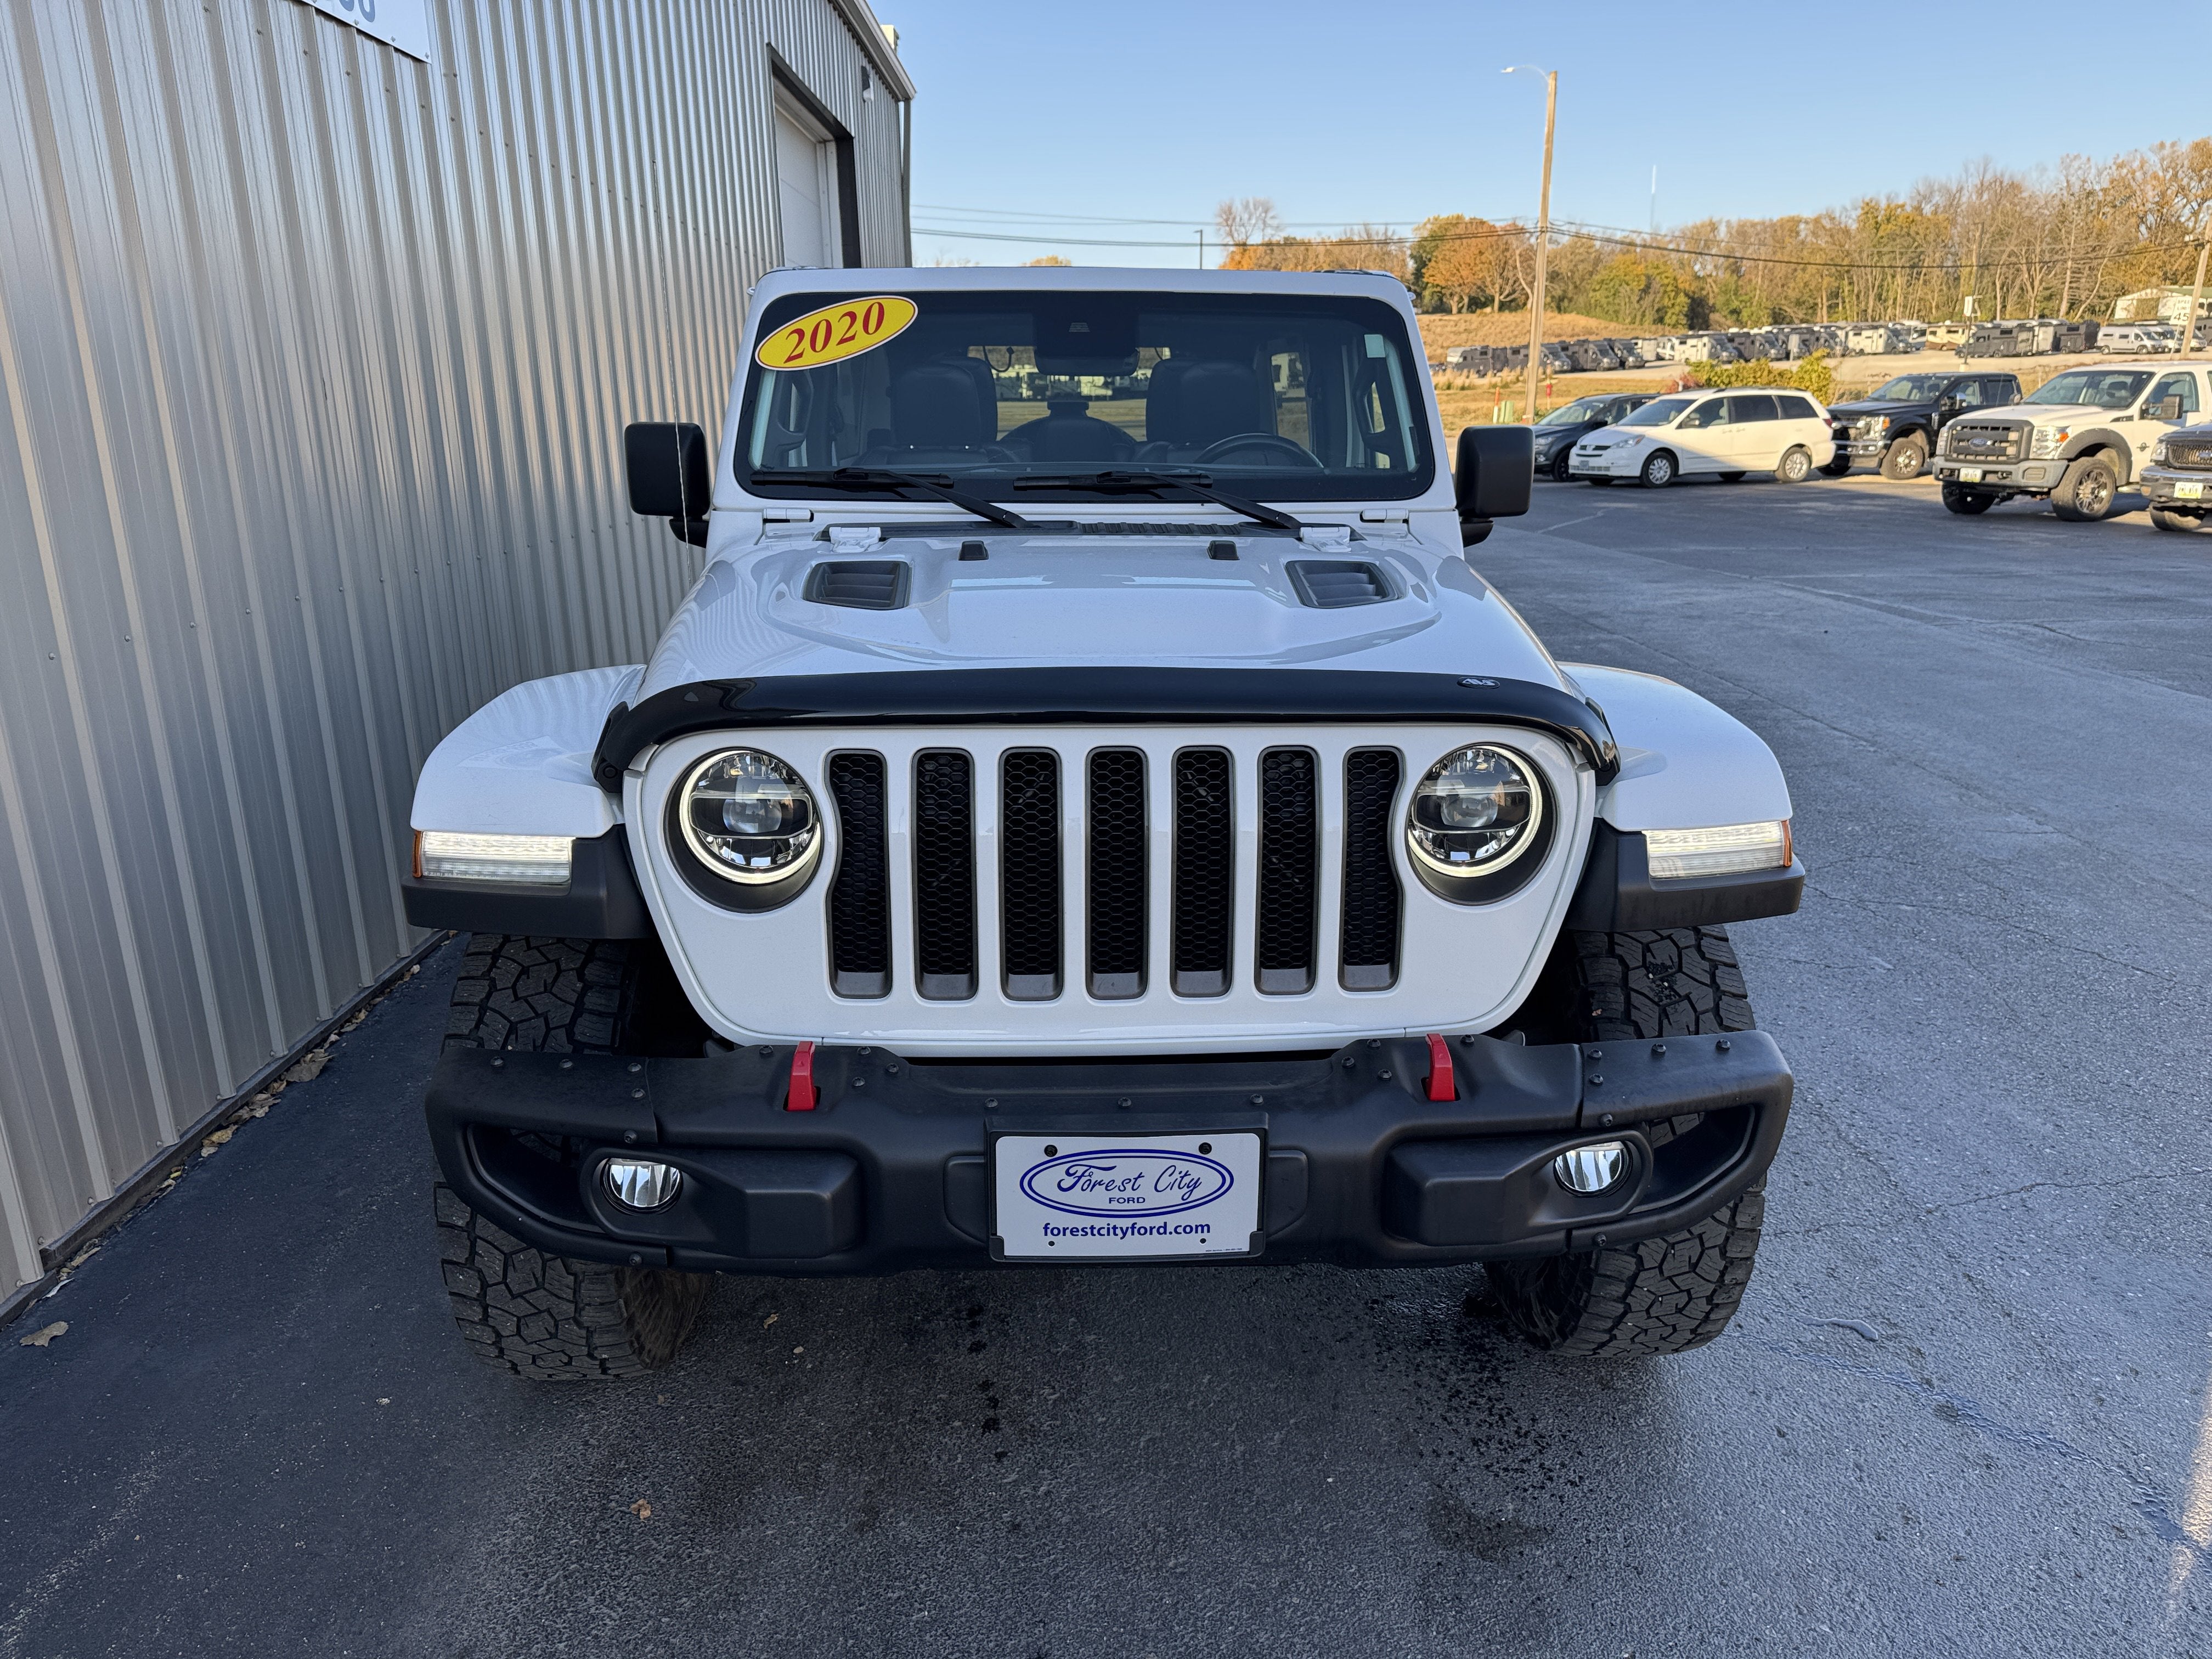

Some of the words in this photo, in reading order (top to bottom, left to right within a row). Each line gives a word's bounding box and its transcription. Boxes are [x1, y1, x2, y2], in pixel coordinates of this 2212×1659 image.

[2174, 312, 2190, 321] 45
[783, 302, 884, 364] 2020
[1057, 1164, 1146, 1192] Forest
[1154, 1165, 1203, 1201] City
[1042, 1221, 1211, 1240] forestcityford.com
